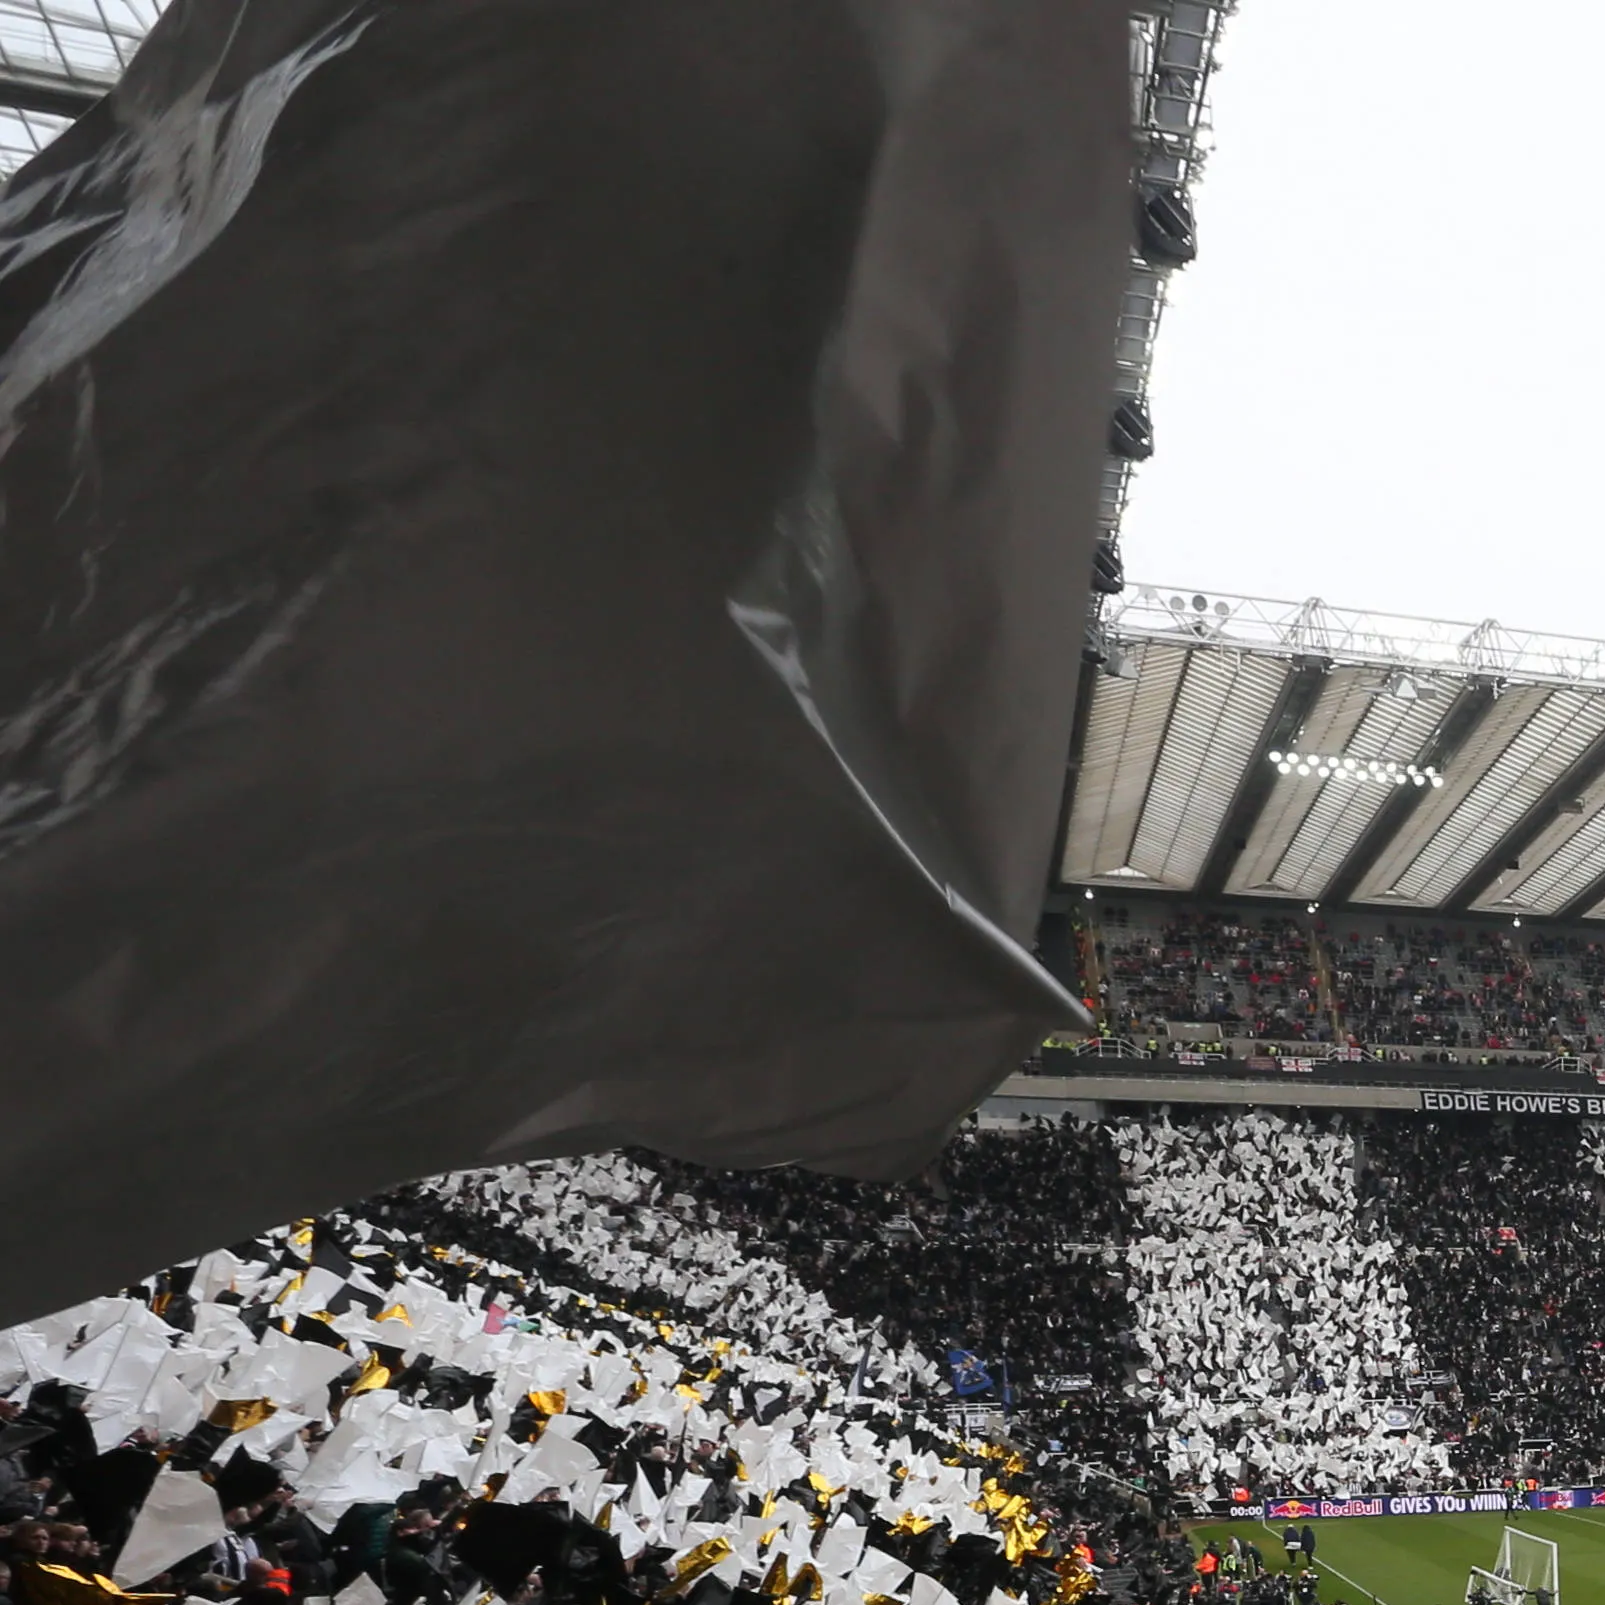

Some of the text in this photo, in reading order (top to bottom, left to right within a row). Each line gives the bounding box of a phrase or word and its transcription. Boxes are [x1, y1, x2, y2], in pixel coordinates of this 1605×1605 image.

[1423, 1092, 1491, 1111] EDDIE
[1496, 1096, 1581, 1114] HOWE'S
[1230, 1506, 1263, 1517] 00:00
[1321, 1500, 1350, 1517] Red
[1350, 1499, 1383, 1516] Bull
[1390, 1496, 1432, 1514] GIVES
